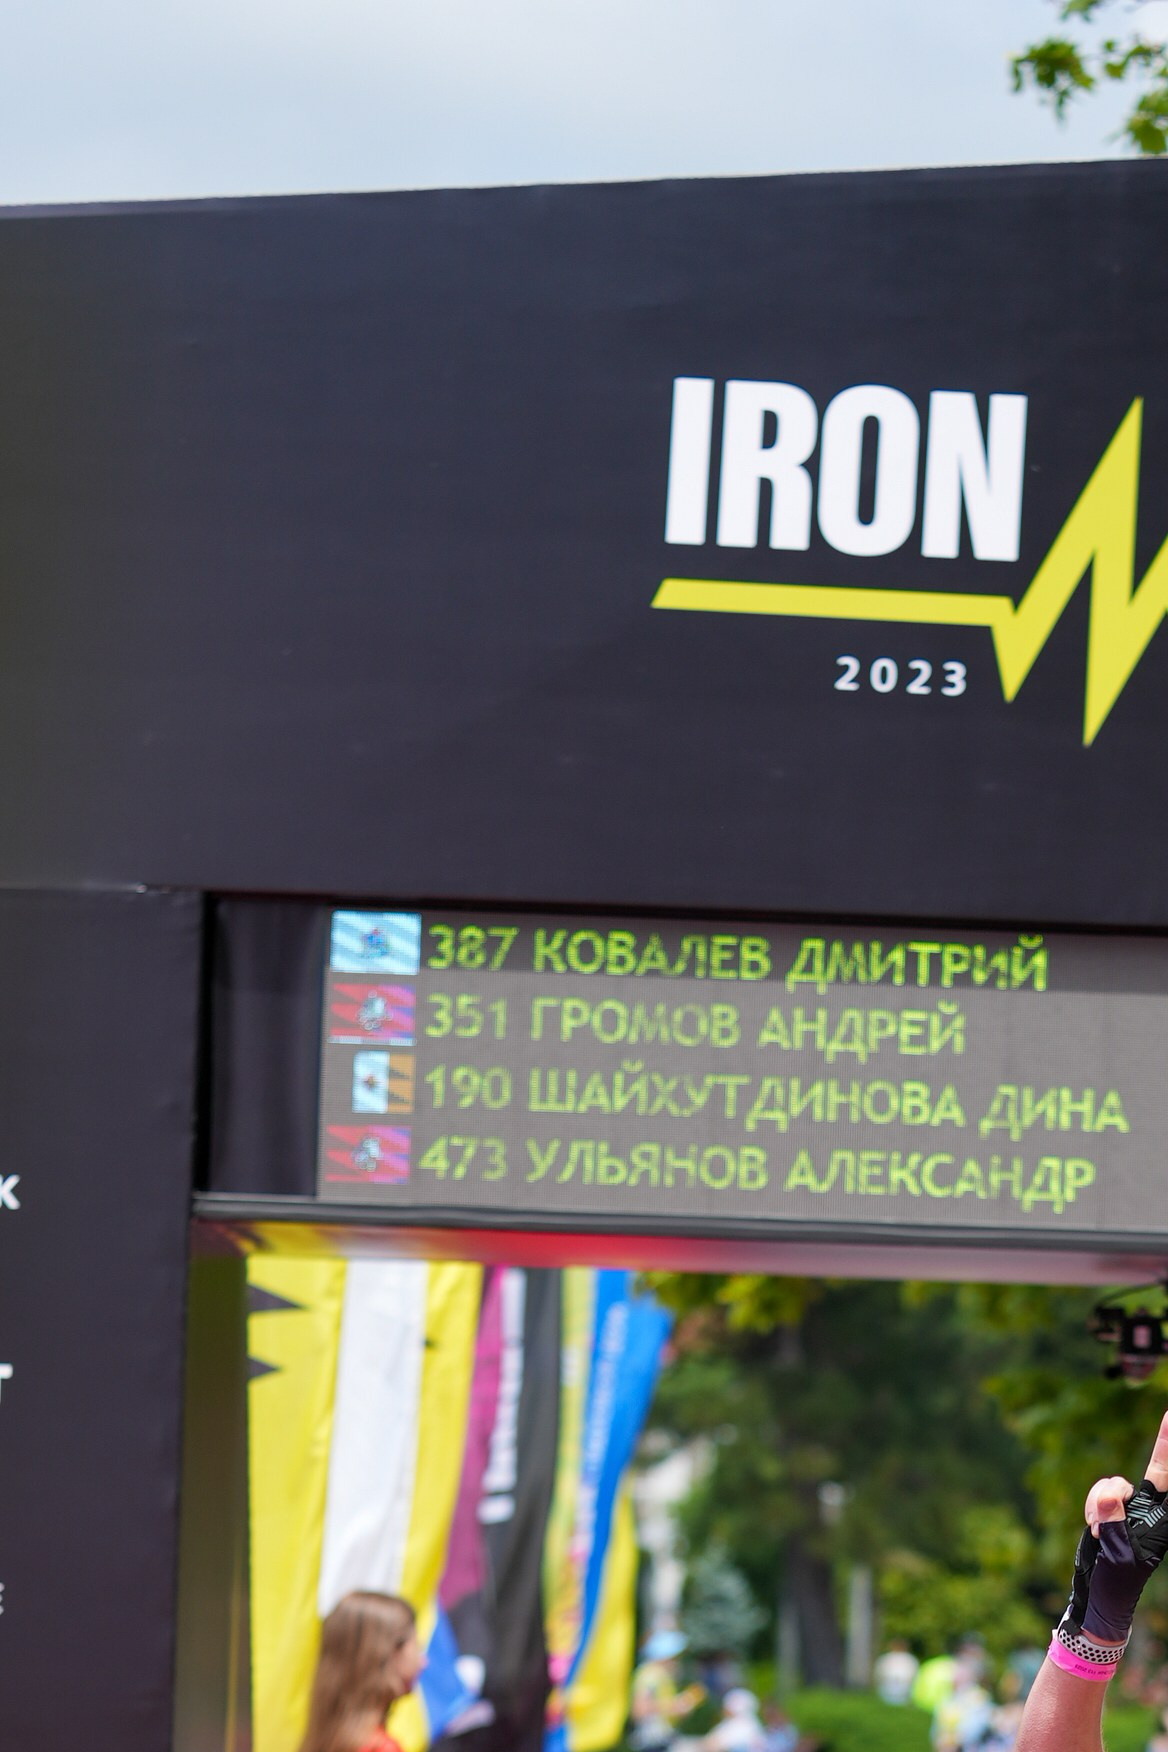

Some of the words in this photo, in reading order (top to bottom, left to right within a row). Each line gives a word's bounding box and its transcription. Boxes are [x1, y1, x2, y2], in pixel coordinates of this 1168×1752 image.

[665, 377, 1028, 562] IRON
[834, 656, 968, 697] 2023
[427, 925, 519, 971] 387
[534, 928, 771, 981] КОВАЛЕВ
[786, 934, 1049, 994] ДМИТРИЙ
[425, 993, 506, 1038] 351
[531, 997, 740, 1049] ГРОМОВ
[758, 1000, 965, 1064] АНДРЕЙ
[425, 1065, 511, 1110] 190
[528, 1060, 965, 1132] ШАЙХУТДИНОВА
[980, 1084, 1130, 1141] ДИНА
[419, 1135, 508, 1181] 473
[526, 1138, 768, 1191] УЛЬЯНОВ
[784, 1149, 1096, 1213] АЛЕКСАНДР
